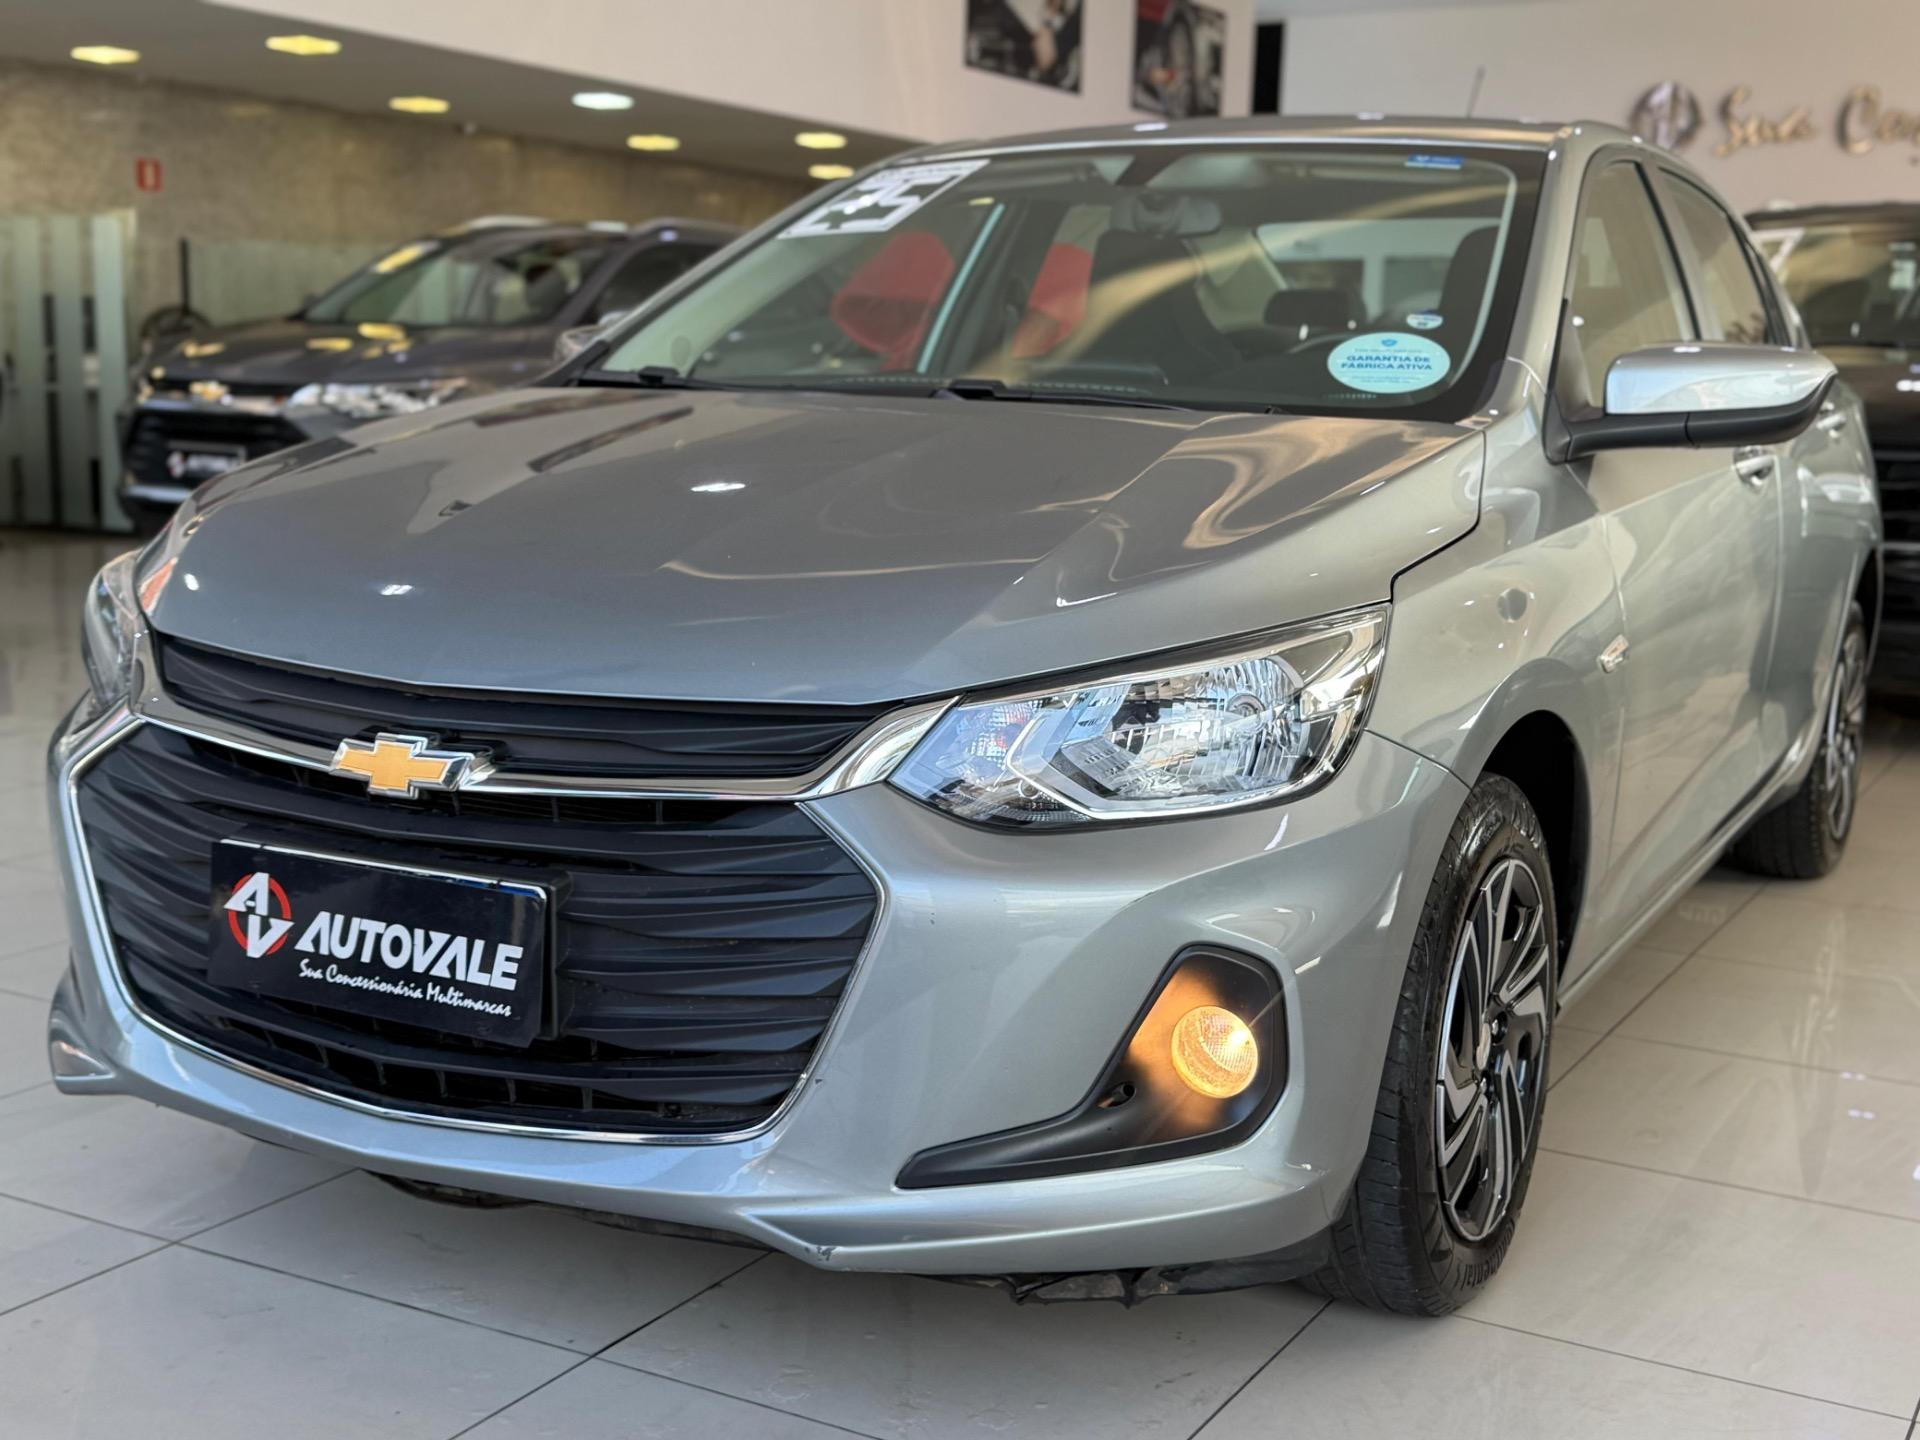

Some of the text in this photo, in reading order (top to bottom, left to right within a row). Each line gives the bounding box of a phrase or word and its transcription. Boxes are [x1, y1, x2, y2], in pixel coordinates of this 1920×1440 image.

[1346, 355, 1412, 363] GARANTIA
[294, 911, 524, 991] AUTOVALE
[299, 957, 323, 979] Sua
[426, 982, 512, 1018] Multimarcas
